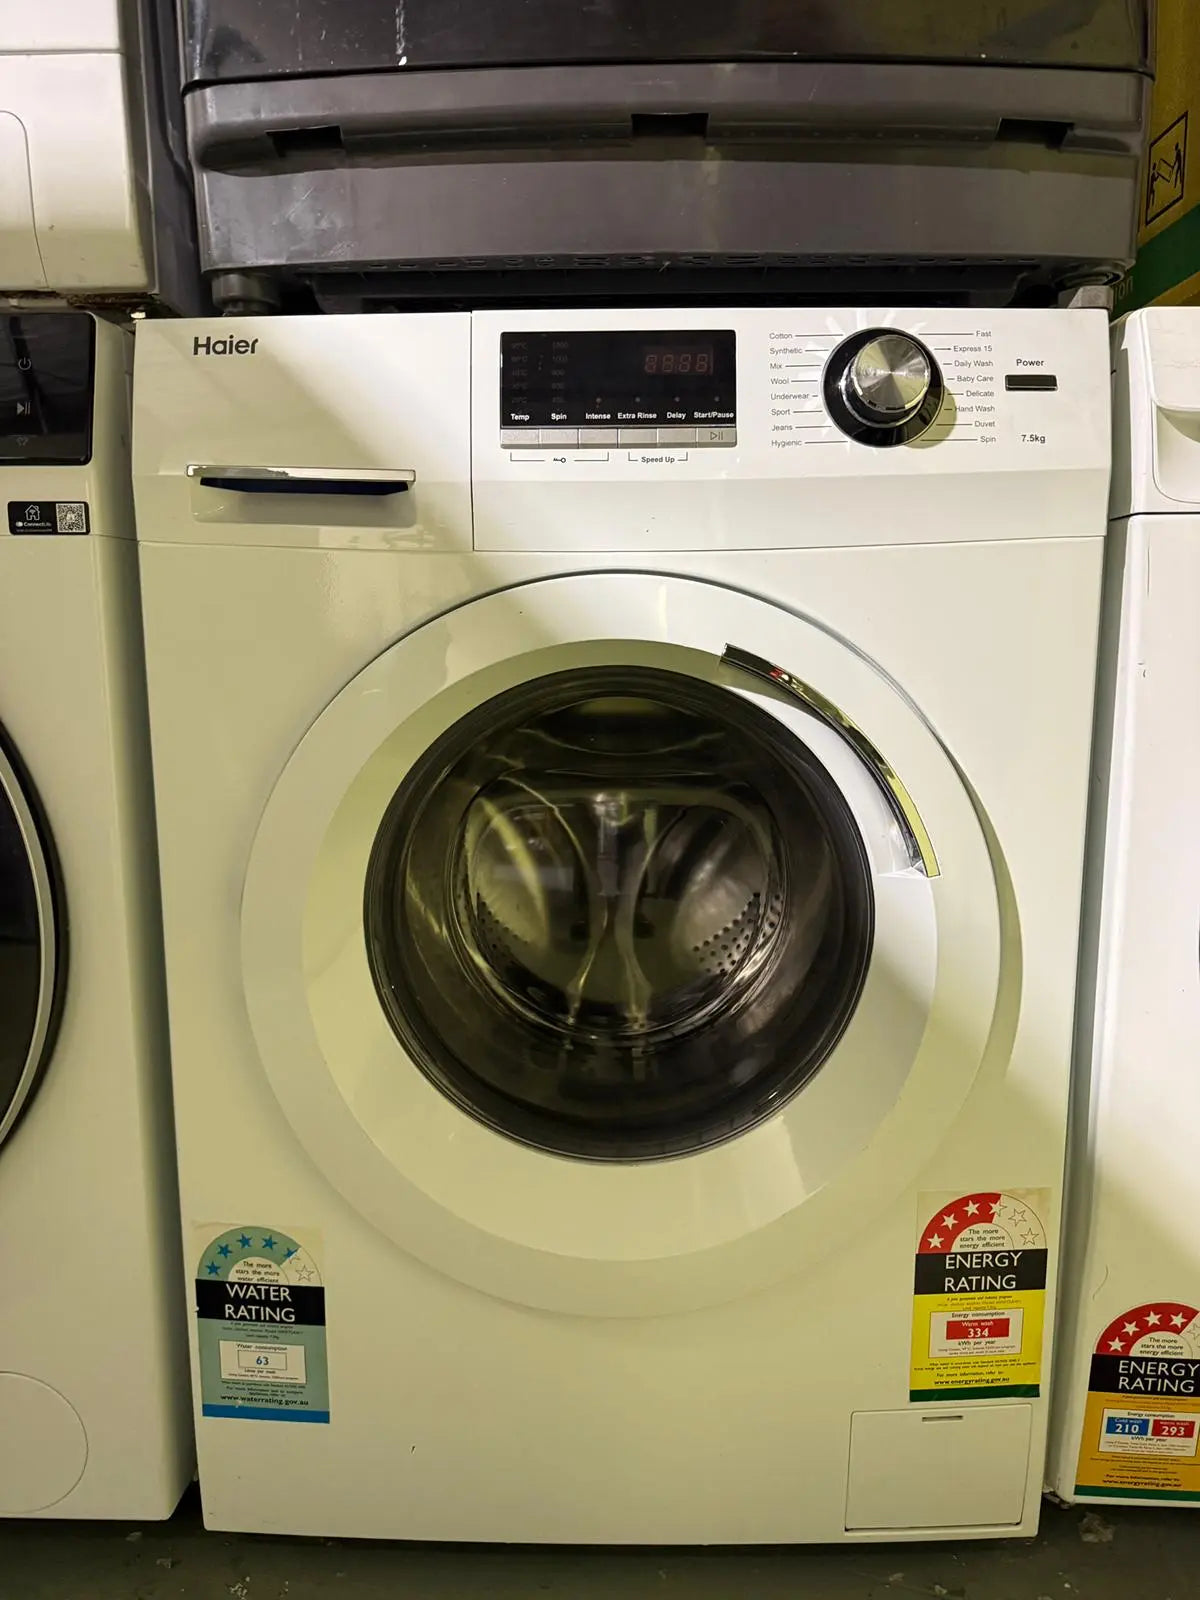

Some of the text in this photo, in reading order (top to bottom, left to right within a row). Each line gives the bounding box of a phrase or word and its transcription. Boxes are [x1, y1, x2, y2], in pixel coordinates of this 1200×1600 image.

[193, 334, 258, 355] Haier
[769, 347, 803, 355] Synthetic
[954, 360, 971, 368] Daily
[957, 375, 975, 383] Baby
[511, 413, 530, 422] Temp
[551, 412, 567, 421] Spin
[586, 412, 611, 420] Intense
[635, 411, 657, 419] Rinse
[666, 411, 686, 420] Delay
[694, 411, 734, 419] Start/Pause
[771, 409, 790, 417] Sport
[771, 439, 802, 447] Hygienic
[1021, 435, 1046, 444] 7.5kg
[641, 456, 675, 464] Speed Up
[945, 1252, 1023, 1270] ENERGY
[944, 1275, 1016, 1292] RATING
[225, 1283, 292, 1303] WATER
[225, 1304, 295, 1323] RATING
[967, 1328, 989, 1338] 334
[256, 1356, 269, 1366] 63
[1118, 1360, 1200, 1377] ENERGY
[934, 1377, 1010, 1386] www.energyrating.gov.au
[1118, 1376, 1195, 1393] RATING
[220, 1395, 309, 1406] www.waterrating.gov.au
[1115, 1423, 1139, 1434] 210
[1161, 1426, 1185, 1436] 293
